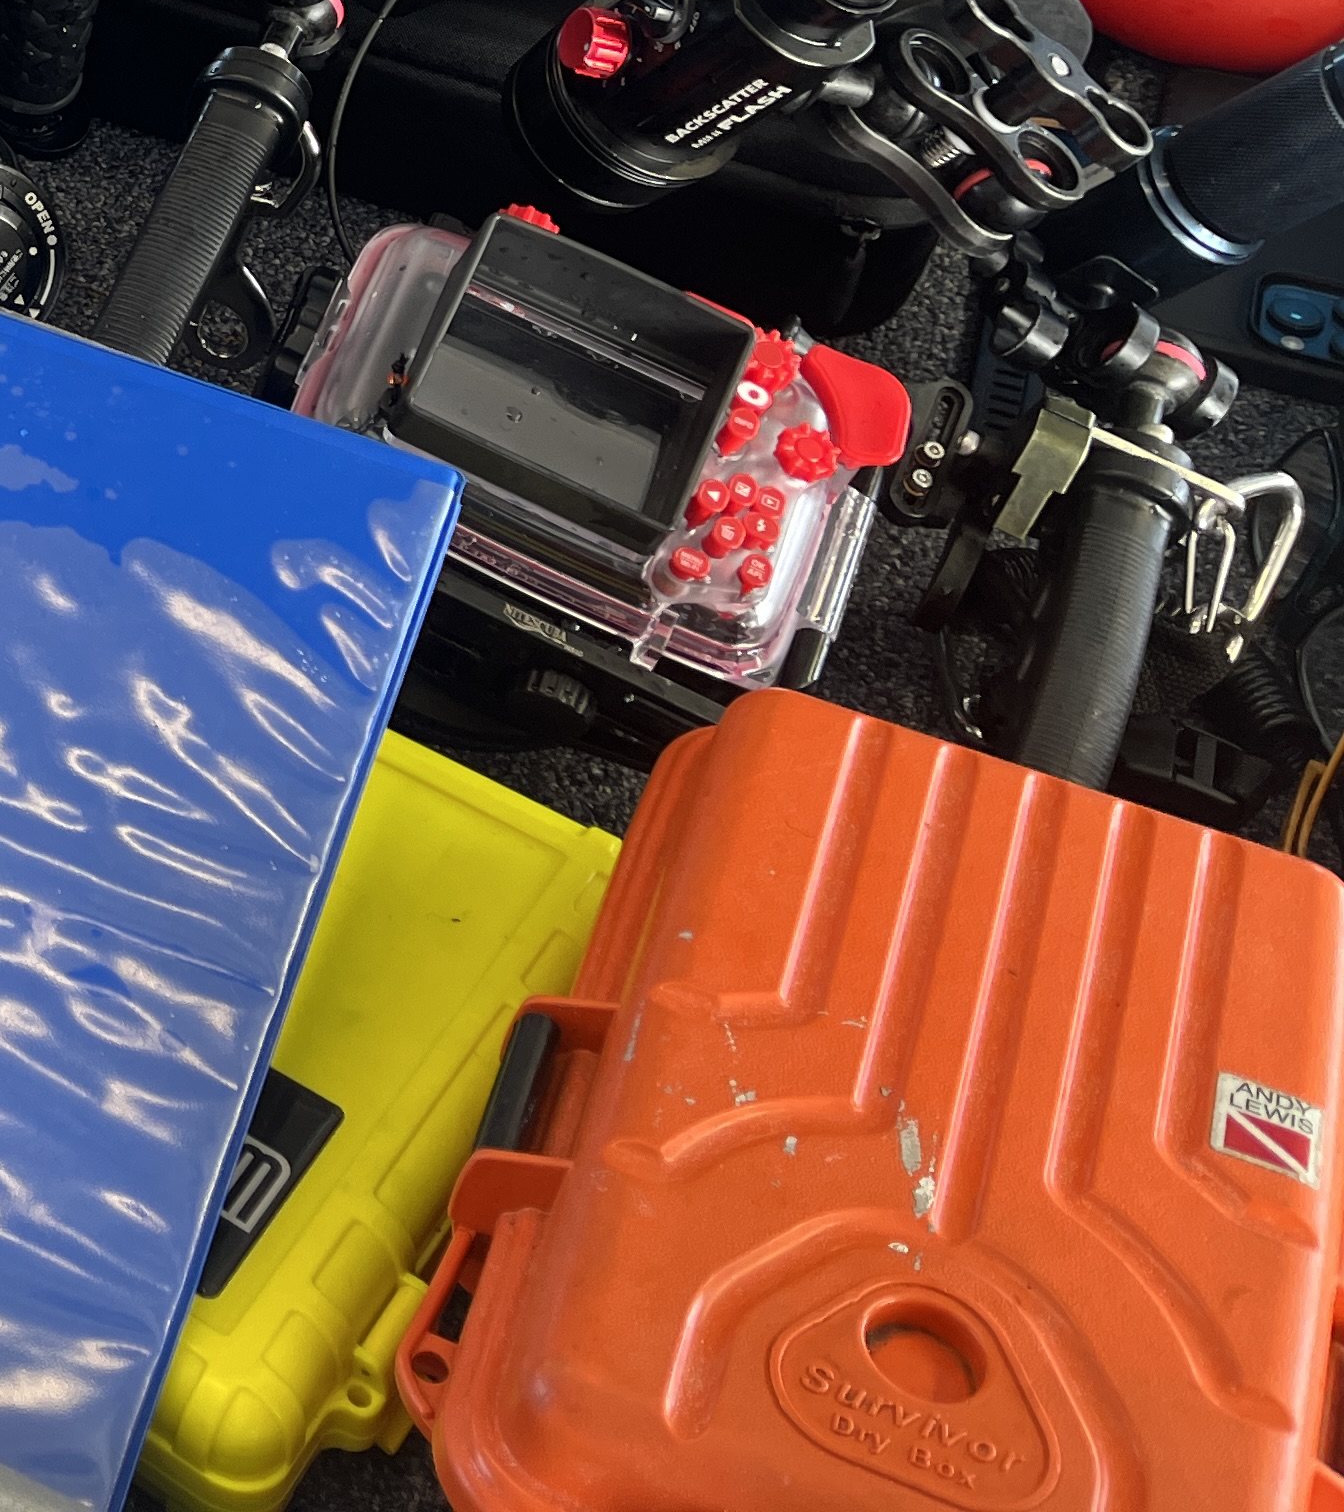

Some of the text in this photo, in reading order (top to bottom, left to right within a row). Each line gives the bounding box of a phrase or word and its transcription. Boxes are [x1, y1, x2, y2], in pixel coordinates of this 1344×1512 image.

[664, 78, 769, 144] BACKSCATTER
[717, 85, 792, 130] FLASH
[24, 191, 55, 234] OPEN
[1227, 1091, 1315, 1135] LEWIS
[1233, 1080, 1314, 1118] ANDY
[799, 1360, 1029, 1473] Survivor
[830, 1412, 979, 1490] Dry Box
